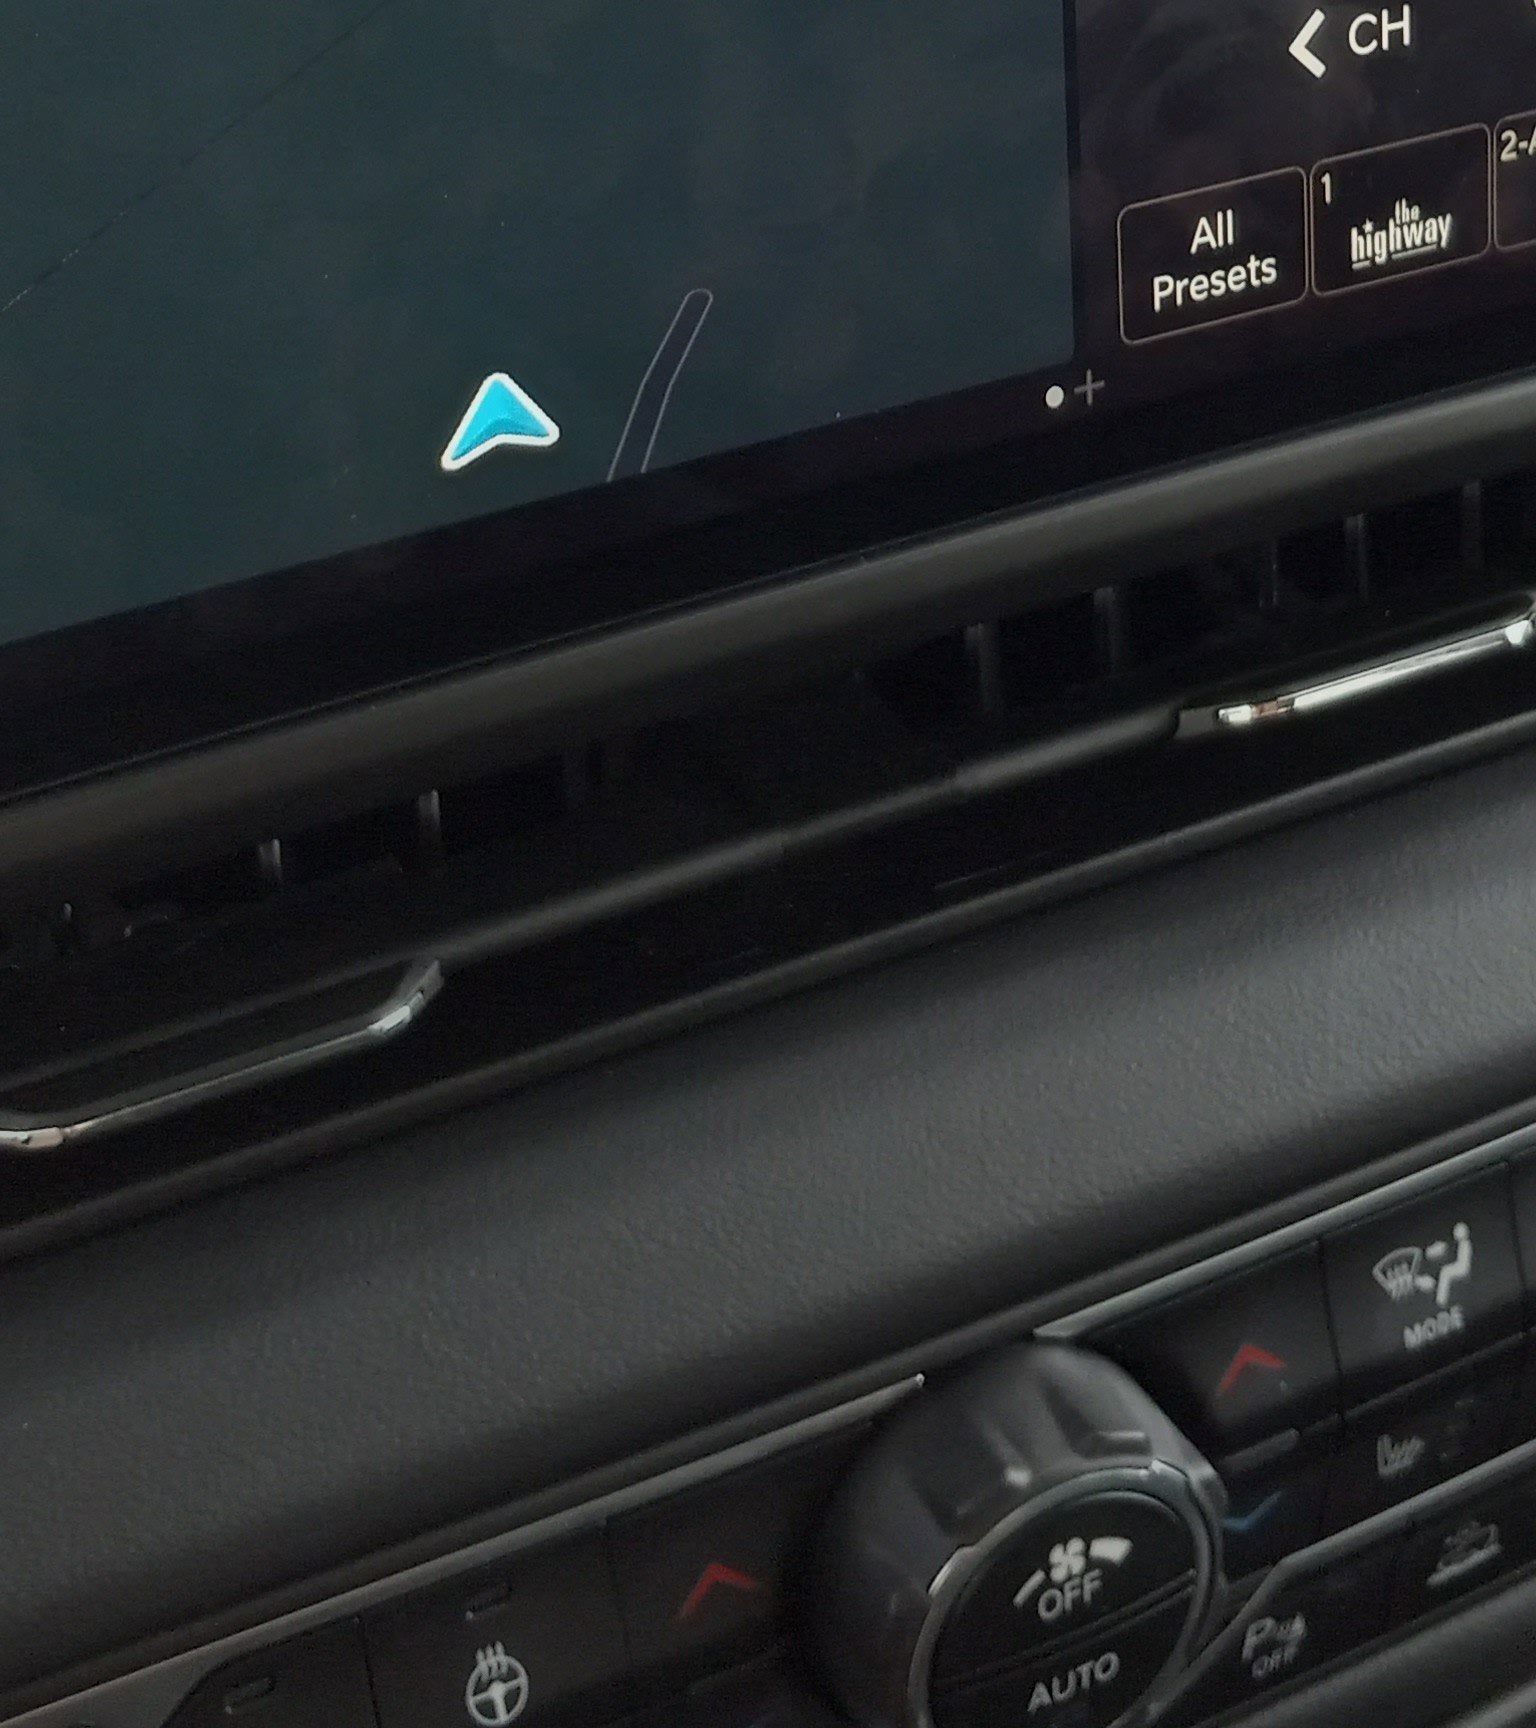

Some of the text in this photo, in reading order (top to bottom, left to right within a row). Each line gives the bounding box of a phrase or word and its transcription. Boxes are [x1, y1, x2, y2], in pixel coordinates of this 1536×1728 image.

[1348, 4, 1412, 55] CH
[1321, 172, 1332, 205] 1
[1394, 197, 1421, 225] the
[1190, 209, 1235, 255] All
[1350, 212, 1452, 266] highway
[1152, 254, 1278, 313] Presets
[1038, 1572, 1104, 1622] OFF
[1028, 1652, 1120, 1713] AUTO
